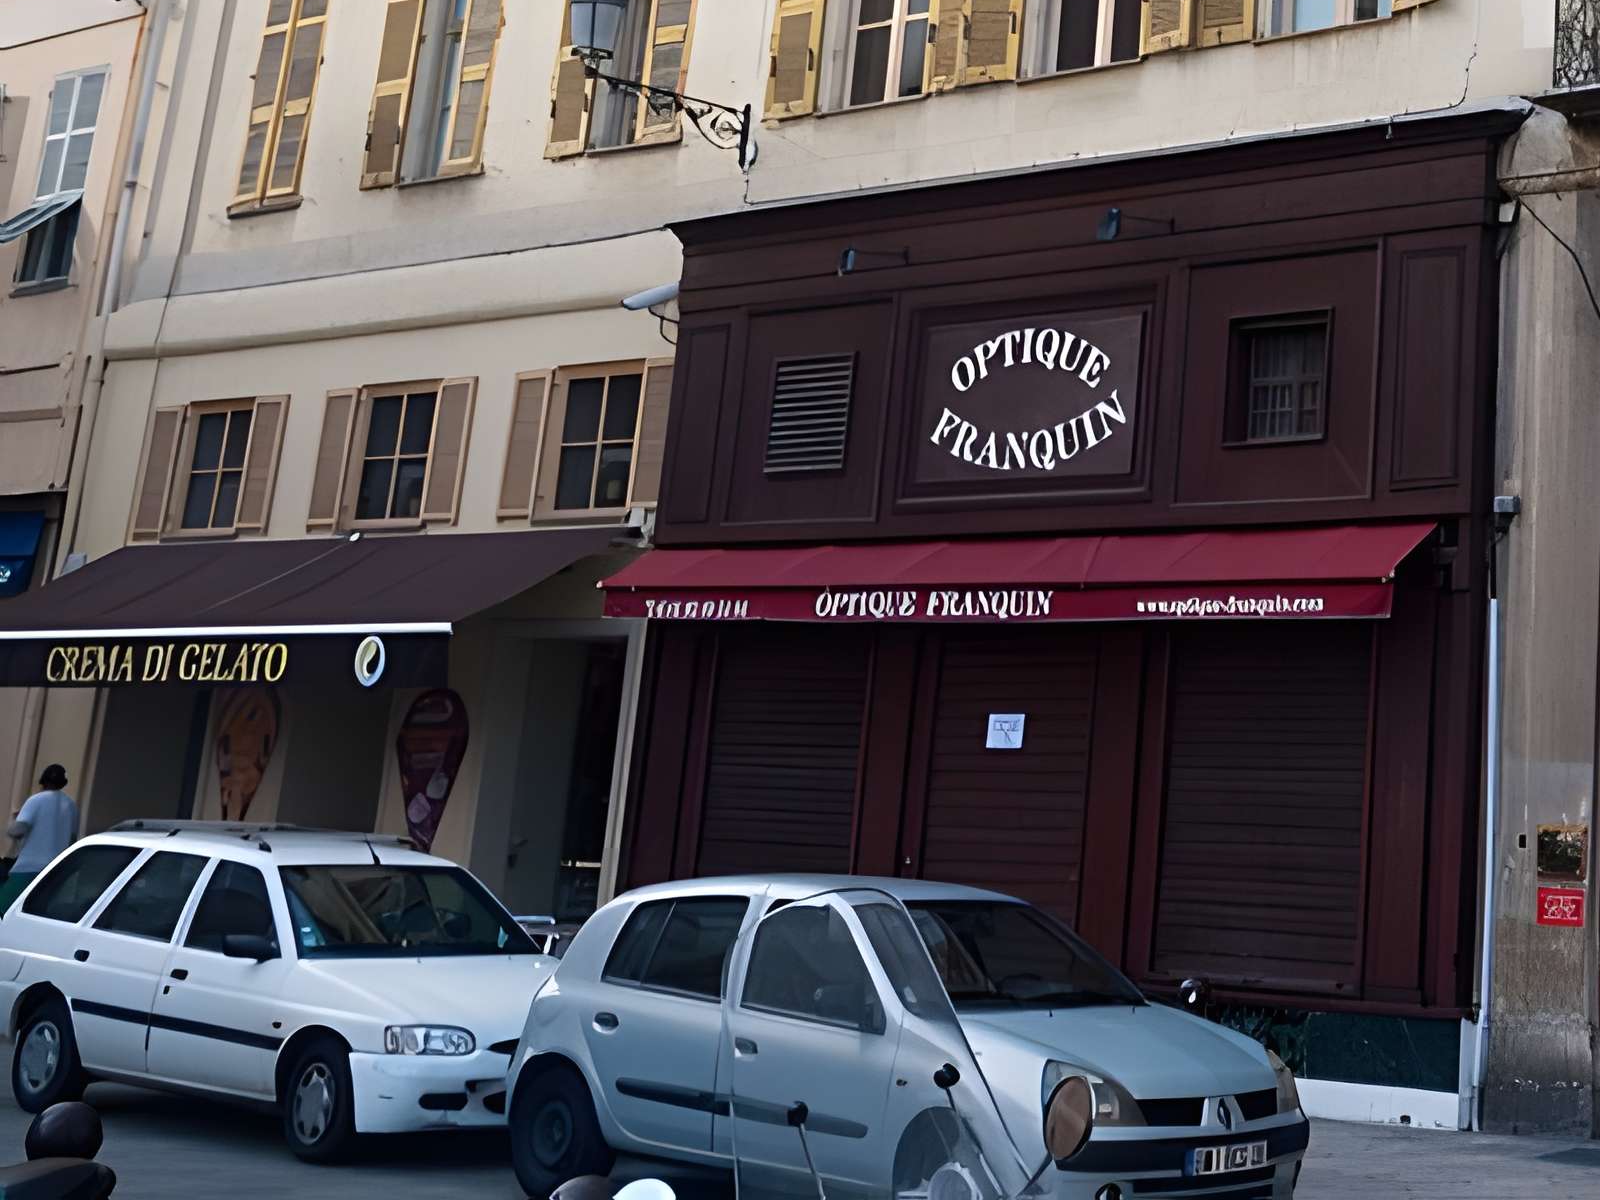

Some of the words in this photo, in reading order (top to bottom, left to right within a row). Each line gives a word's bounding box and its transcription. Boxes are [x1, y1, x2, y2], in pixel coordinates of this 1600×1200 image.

[951, 327, 1111, 392] OPTIQUE
[930, 389, 1127, 471] FRANQUIN
[815, 589, 917, 619] OPTIQUE
[926, 589, 1054, 619] FRANQUIN
[46, 643, 134, 682] CREMA
[142, 643, 173, 682] DI
[179, 642, 288, 683] GELATO
